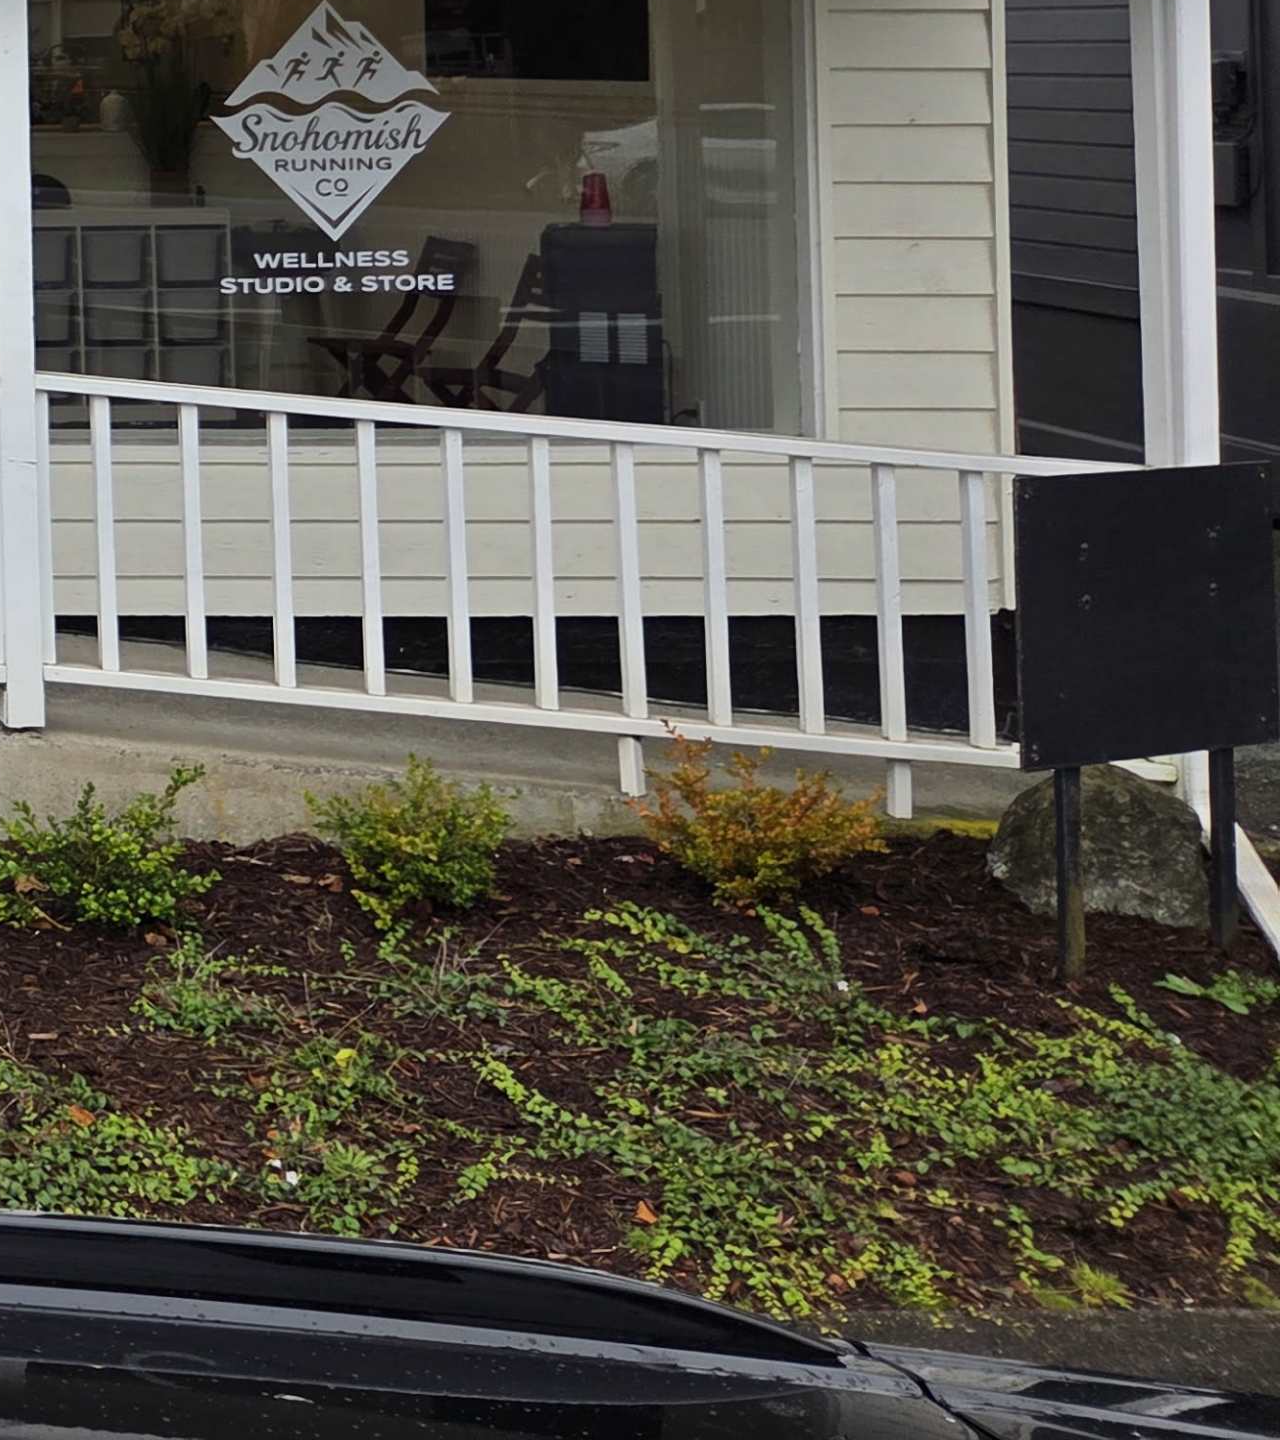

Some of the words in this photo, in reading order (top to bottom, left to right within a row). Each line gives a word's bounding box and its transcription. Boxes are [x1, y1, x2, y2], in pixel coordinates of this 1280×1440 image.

[233, 113, 428, 153] Snohomish
[274, 157, 393, 173] RUNNING
[253, 250, 410, 269] WELLNESS
[220, 276, 325, 295] STUDIO
[333, 276, 353, 293] &
[361, 274, 455, 292] STORE
